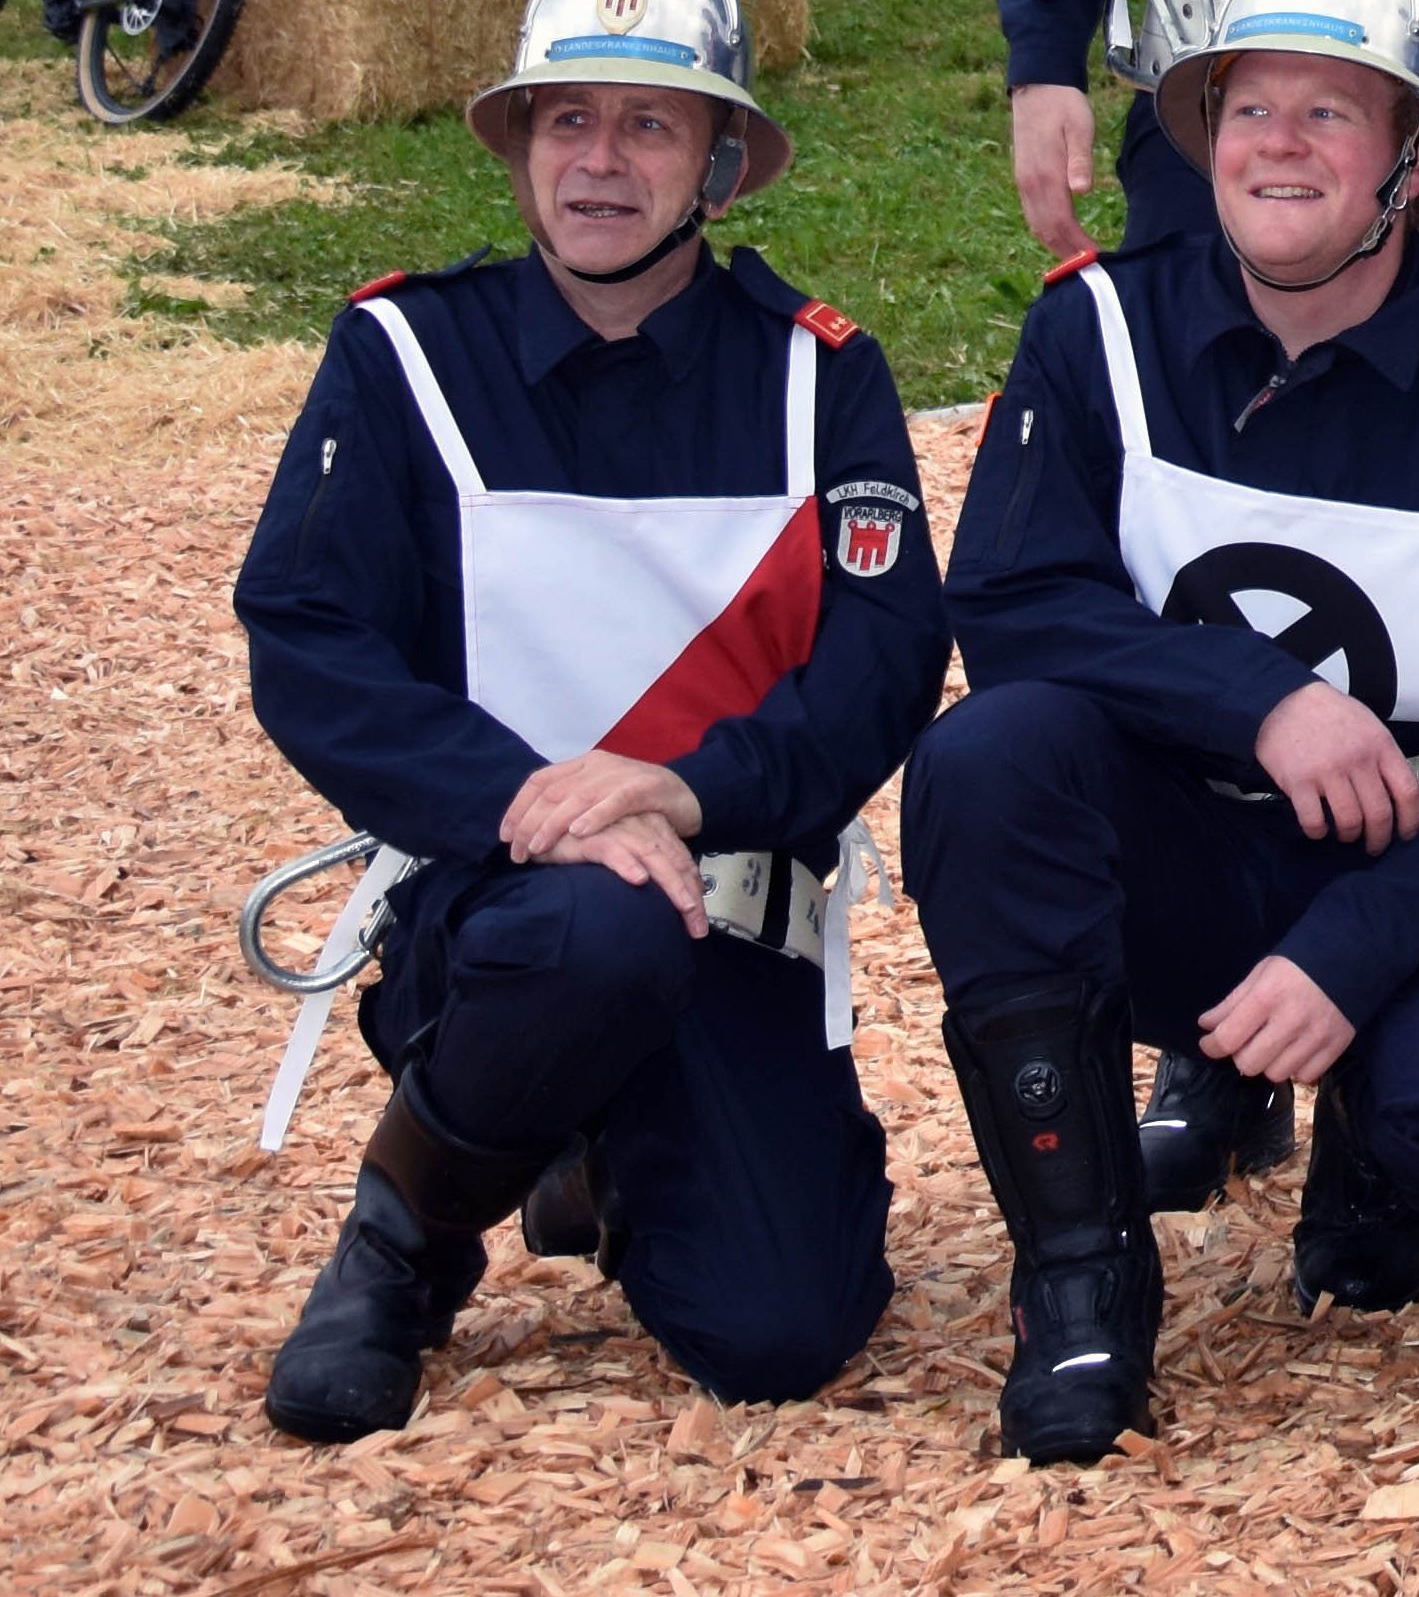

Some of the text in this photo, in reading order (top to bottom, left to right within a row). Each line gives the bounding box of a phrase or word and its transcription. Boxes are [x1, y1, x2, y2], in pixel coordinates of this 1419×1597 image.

[836, 482, 910, 505] LKH Feldkirch
[844, 506, 902, 524] VORARLBERG
